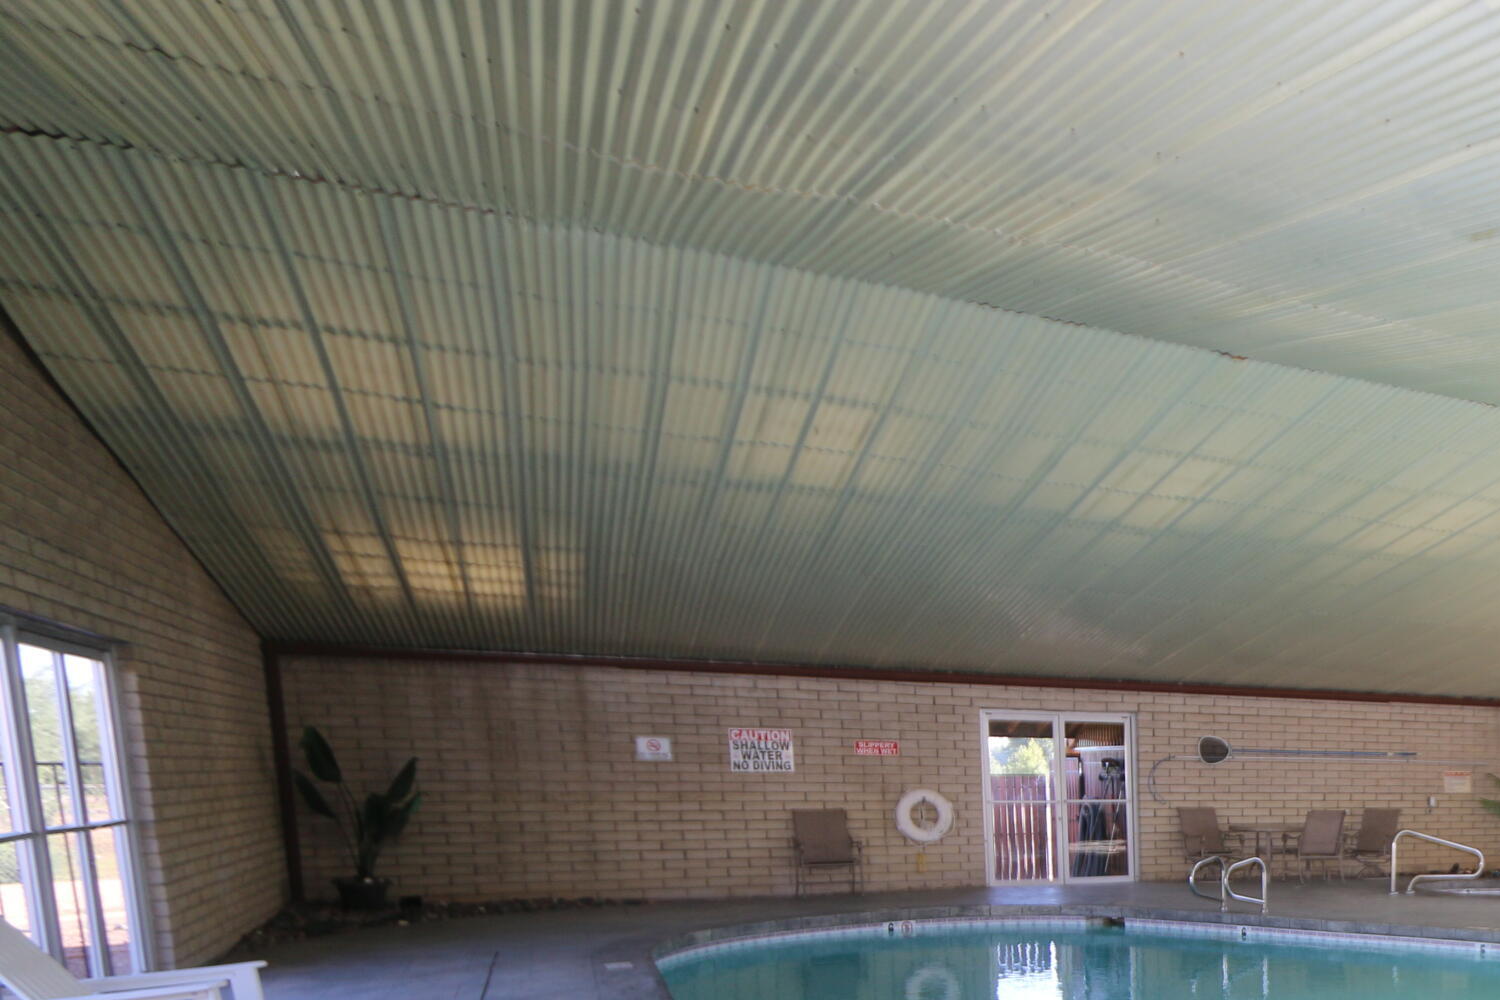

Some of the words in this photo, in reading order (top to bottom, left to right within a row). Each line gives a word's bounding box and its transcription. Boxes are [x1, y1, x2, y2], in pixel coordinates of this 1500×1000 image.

[730, 730, 791, 741] CAUTION
[732, 740, 790, 751] SHALLOW
[741, 750, 783, 761] WATER
[732, 760, 750, 771] NO
[752, 760, 792, 771] DIVING
